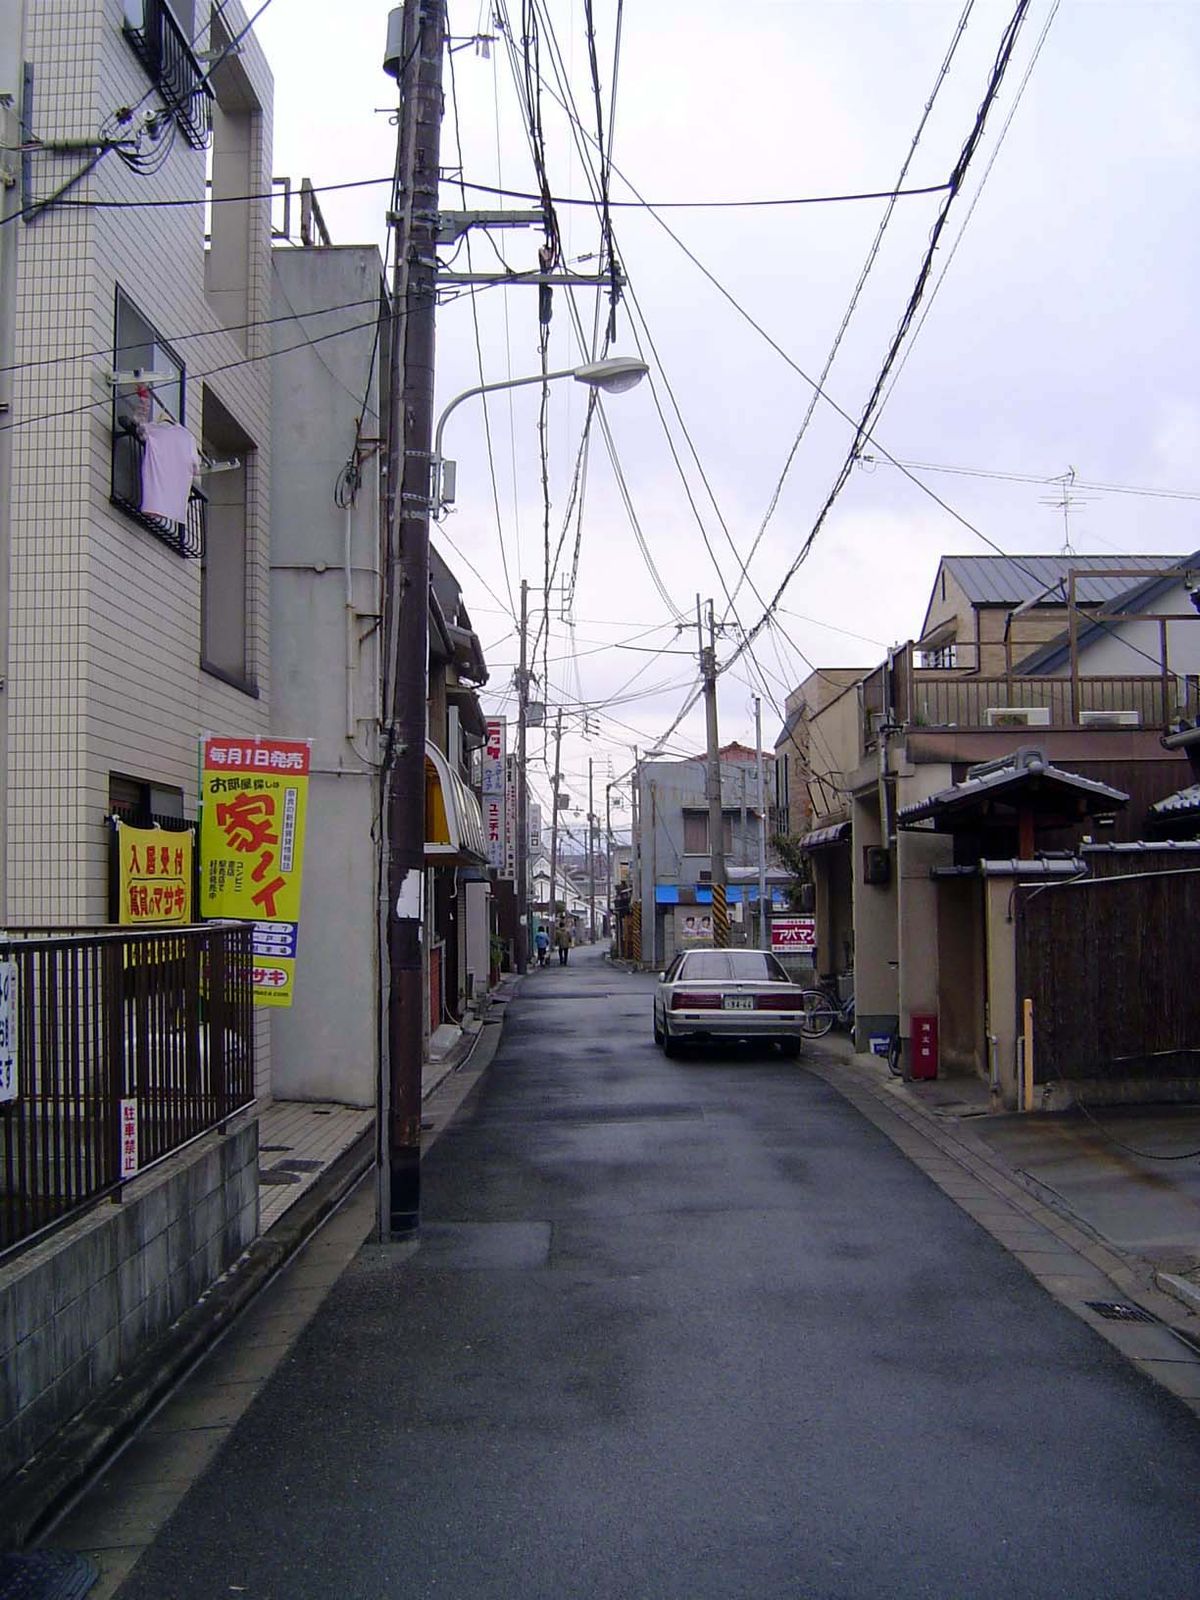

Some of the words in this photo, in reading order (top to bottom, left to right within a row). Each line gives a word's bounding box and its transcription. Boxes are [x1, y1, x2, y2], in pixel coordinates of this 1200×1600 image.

[209, 747, 304, 769] 毎月1日発売
[210, 777, 280, 793] お部屋探しは
[489, 804, 499, 841] ユニチカ
[129, 844, 183, 875] 入居受付
[129, 885, 185, 917] 賃貸のマサキ
[124, 1106, 135, 1171] 駐車禁止
